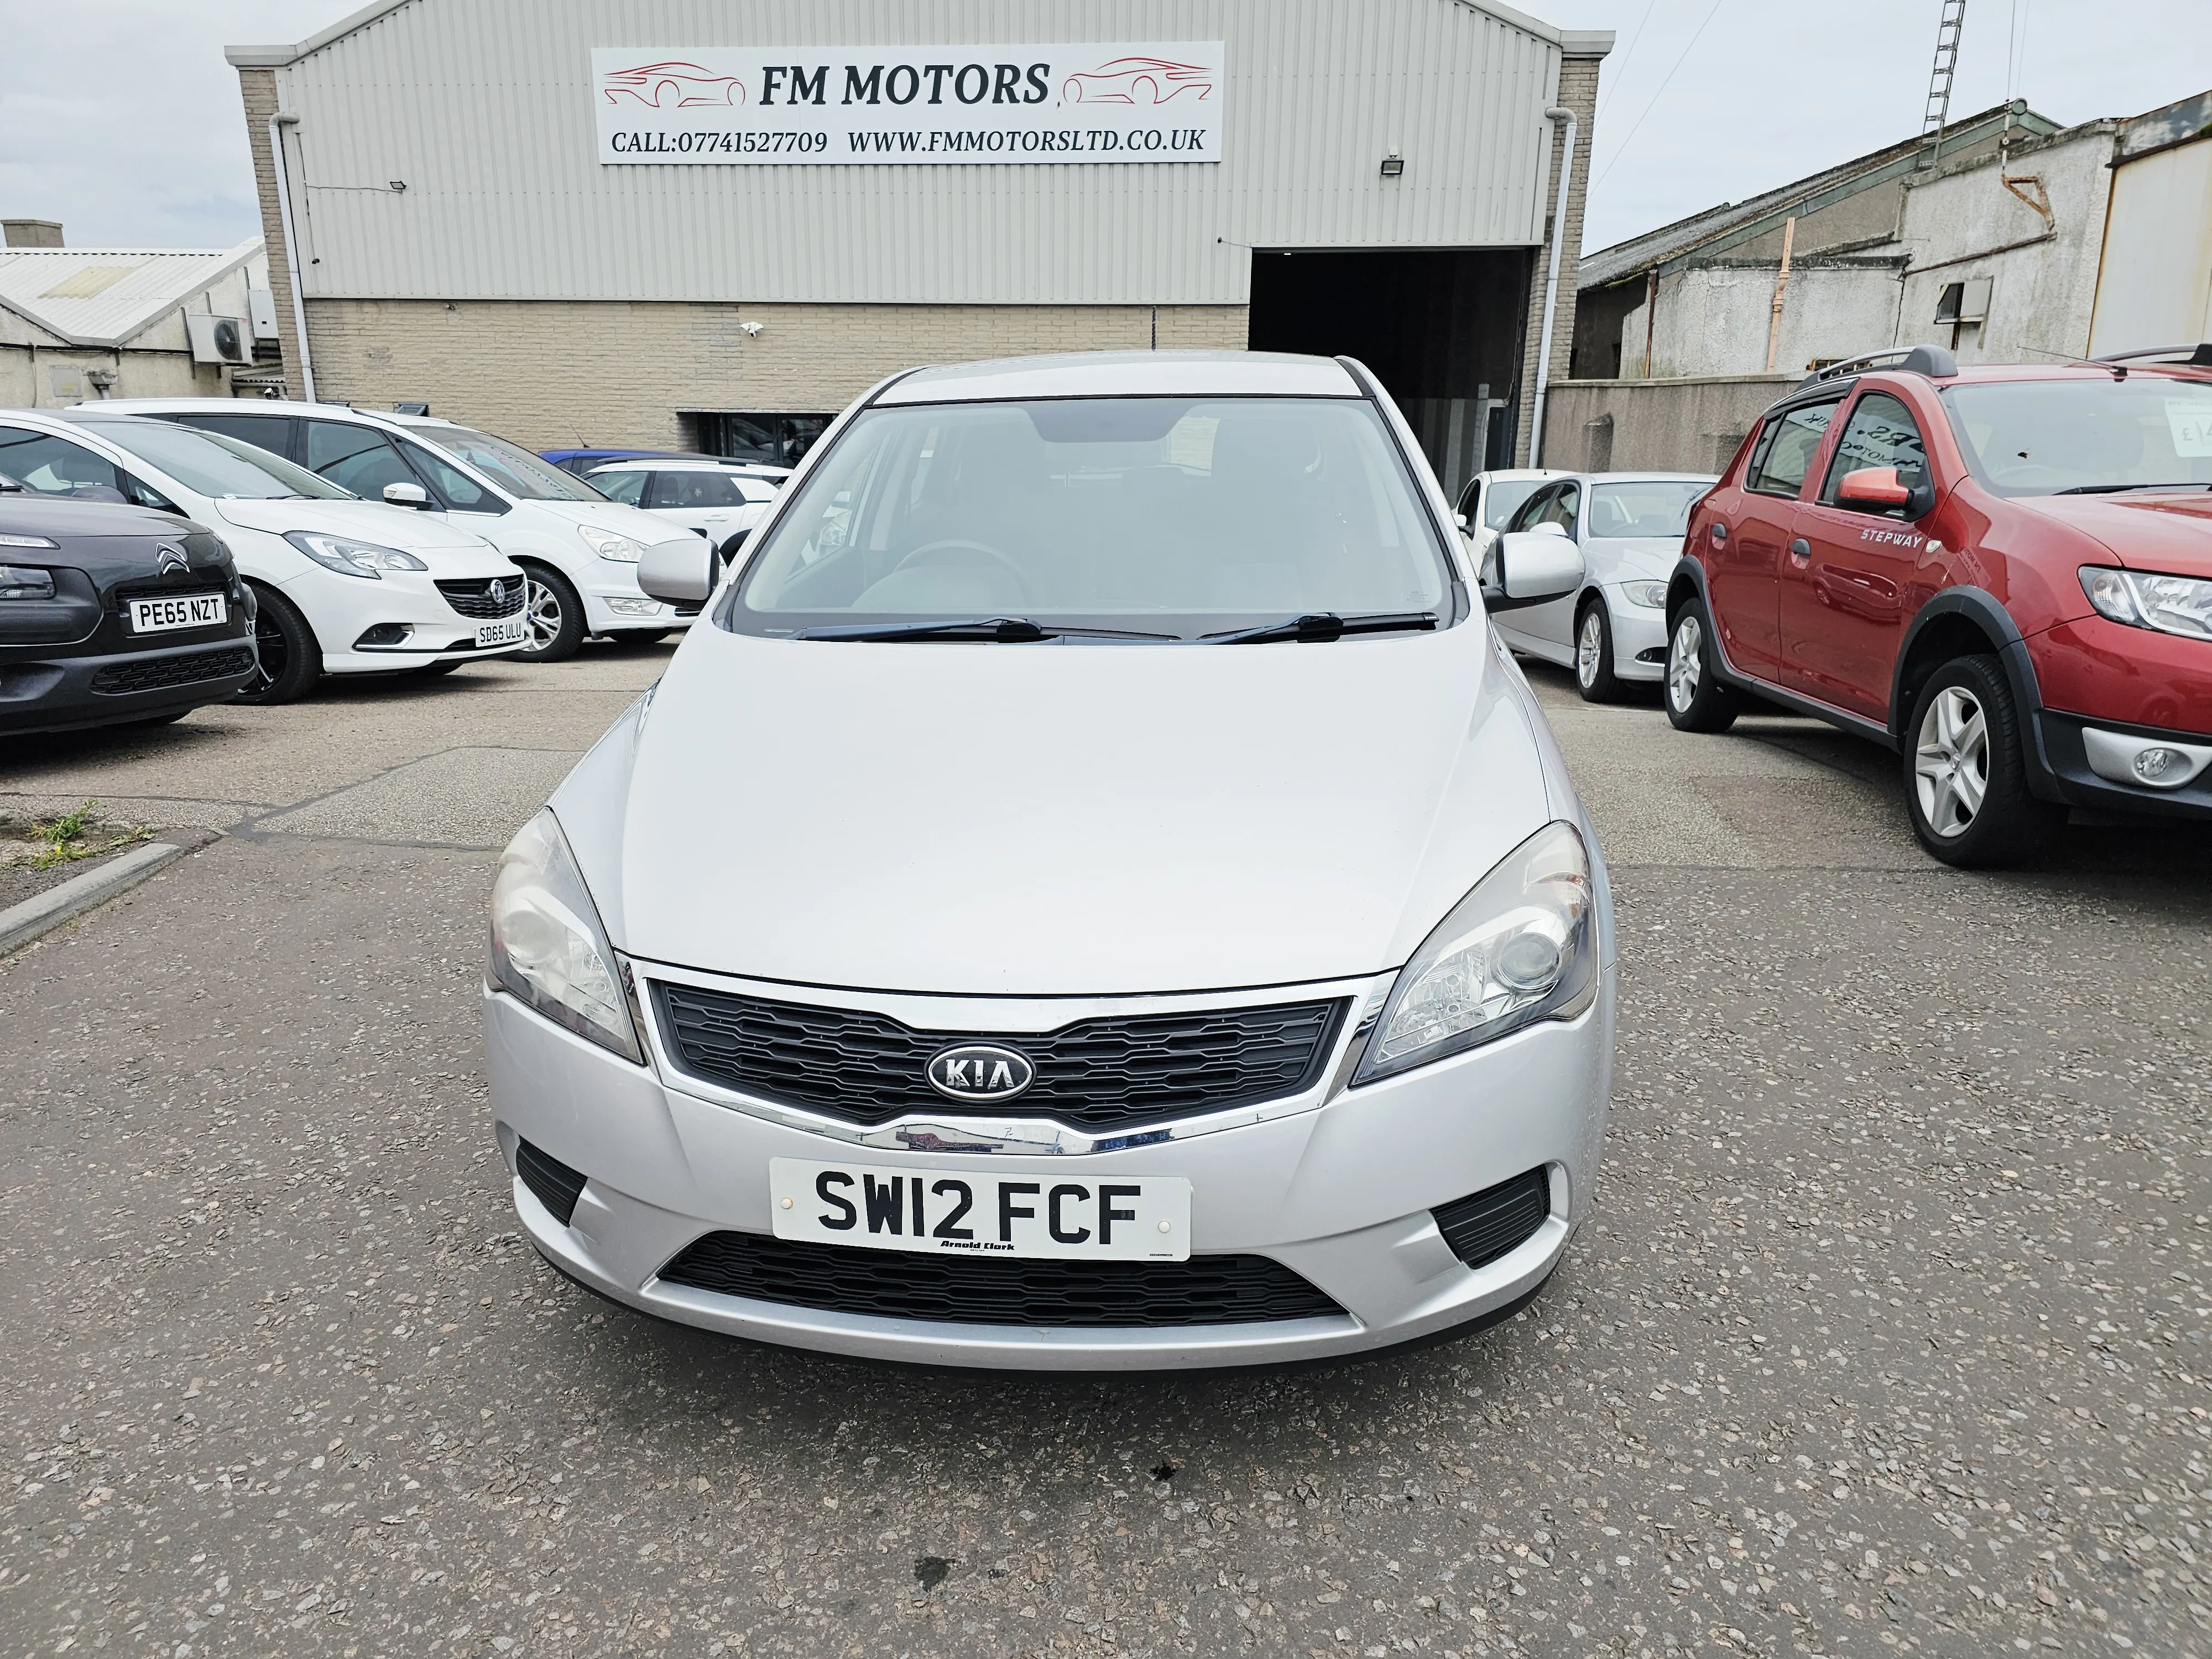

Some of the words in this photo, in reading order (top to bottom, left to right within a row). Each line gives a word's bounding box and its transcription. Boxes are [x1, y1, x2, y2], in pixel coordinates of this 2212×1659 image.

[759, 66, 830, 106] FM
[841, 63, 1051, 105] MOTORS
[612, 132, 827, 152] CALL:07741527709
[848, 129, 1207, 152] WWW.FMMOTORSLTD.CO.UK
[1860, 529, 1923, 548] STEPWAY
[139, 602, 187, 627] PE65
[190, 598, 218, 622] NZT
[479, 625, 504, 643] SD65
[505, 622, 521, 639] ULU
[946, 1059, 1015, 1089] KIA
[816, 1171, 974, 1240] SW12
[998, 1182, 1141, 1245] FCF
[940, 1240, 981, 1249] Arnold
[983, 1243, 1015, 1251] Clark
